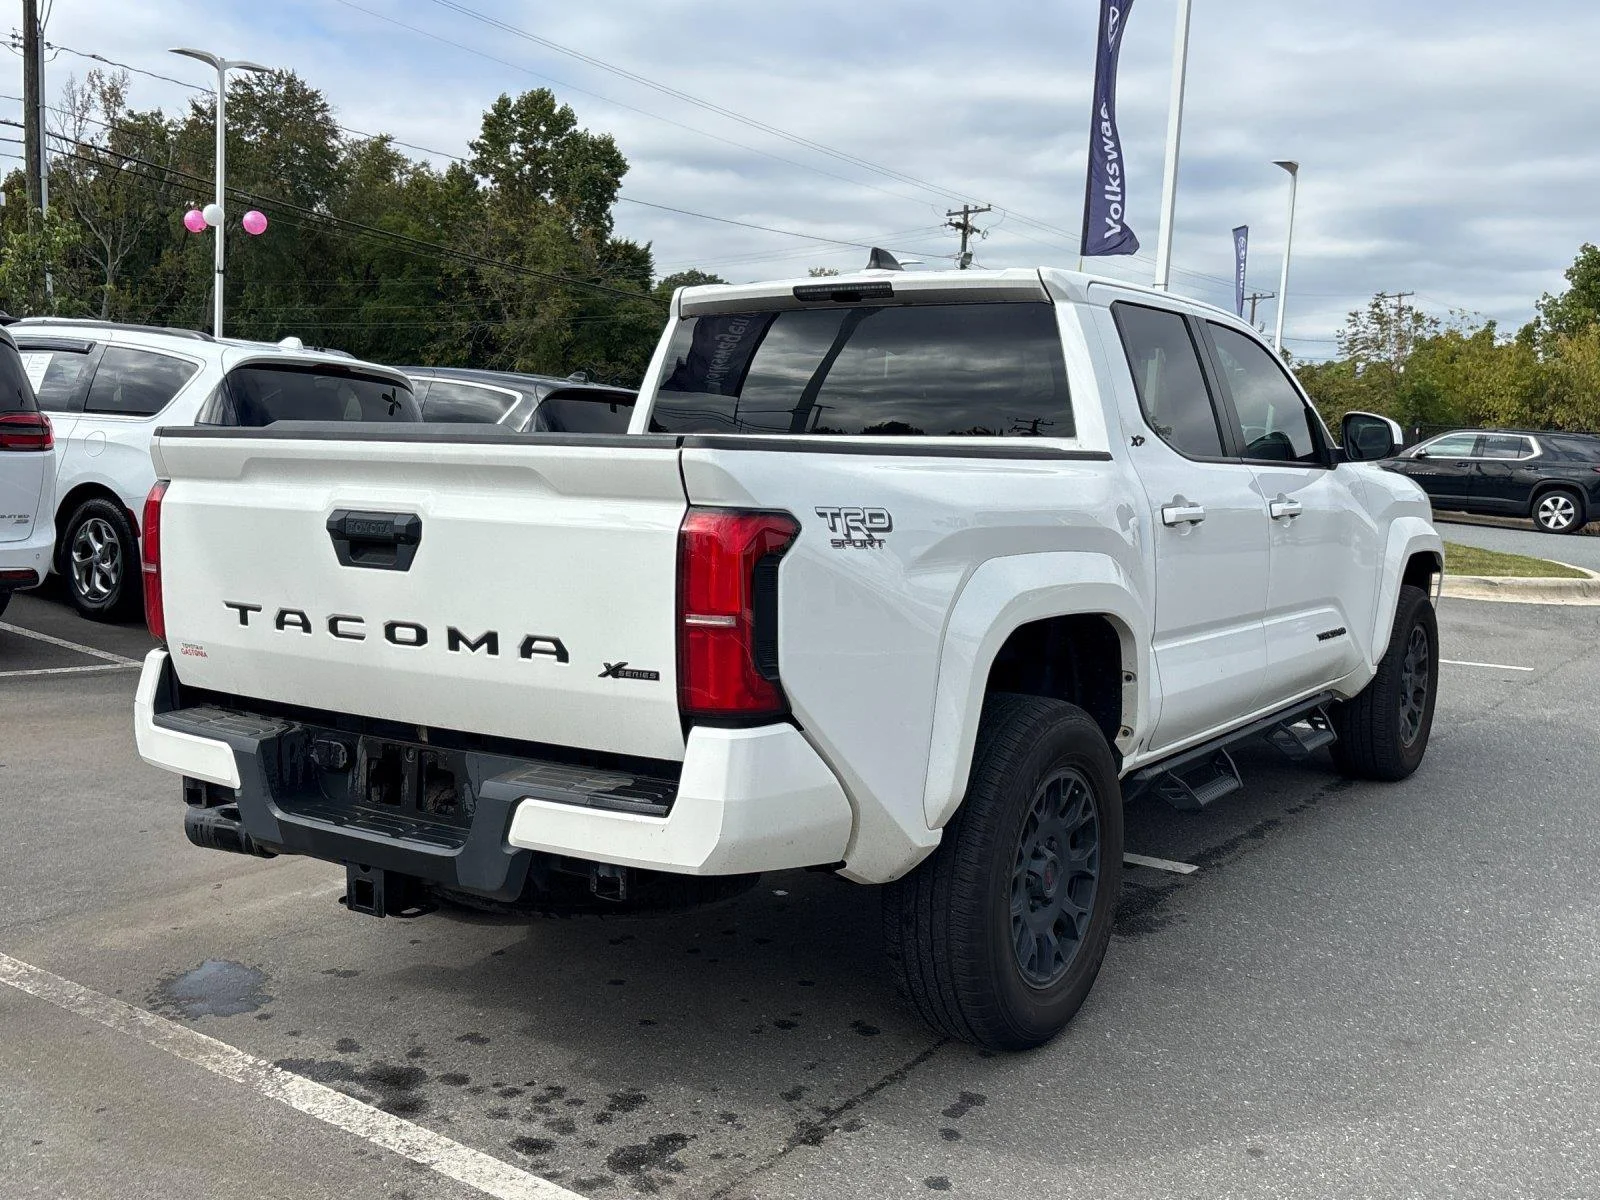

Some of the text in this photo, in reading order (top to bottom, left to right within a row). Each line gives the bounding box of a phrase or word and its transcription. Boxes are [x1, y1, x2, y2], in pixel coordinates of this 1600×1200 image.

[347, 519, 393, 535] TOYOTA
[815, 506, 893, 540] TRD
[830, 539, 887, 549] SPORT
[223, 600, 569, 663] TACOMA
[618, 669, 657, 679] SERIES
